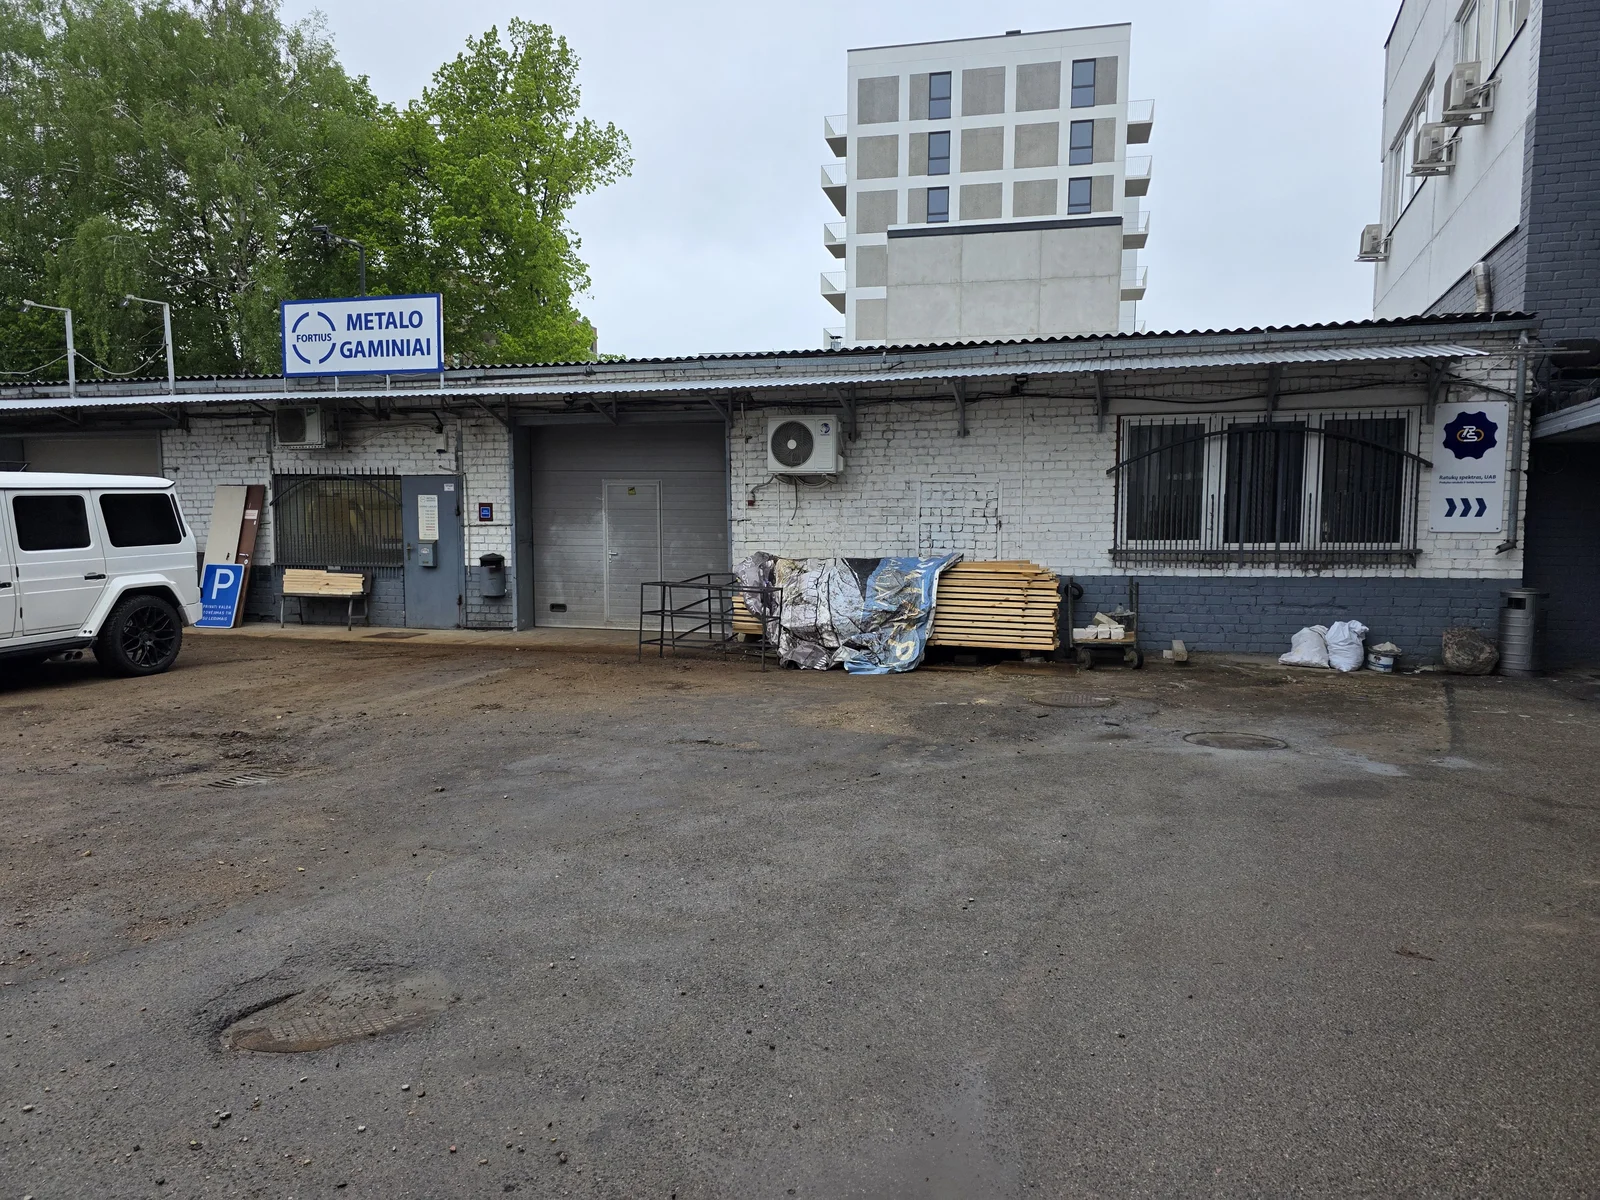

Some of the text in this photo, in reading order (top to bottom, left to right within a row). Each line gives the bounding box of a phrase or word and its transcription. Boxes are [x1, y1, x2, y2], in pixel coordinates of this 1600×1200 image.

[346, 310, 423, 331] METALO
[296, 333, 332, 343] FORTIUS
[339, 338, 431, 359] GAMINIAI
[211, 568, 235, 600] P
